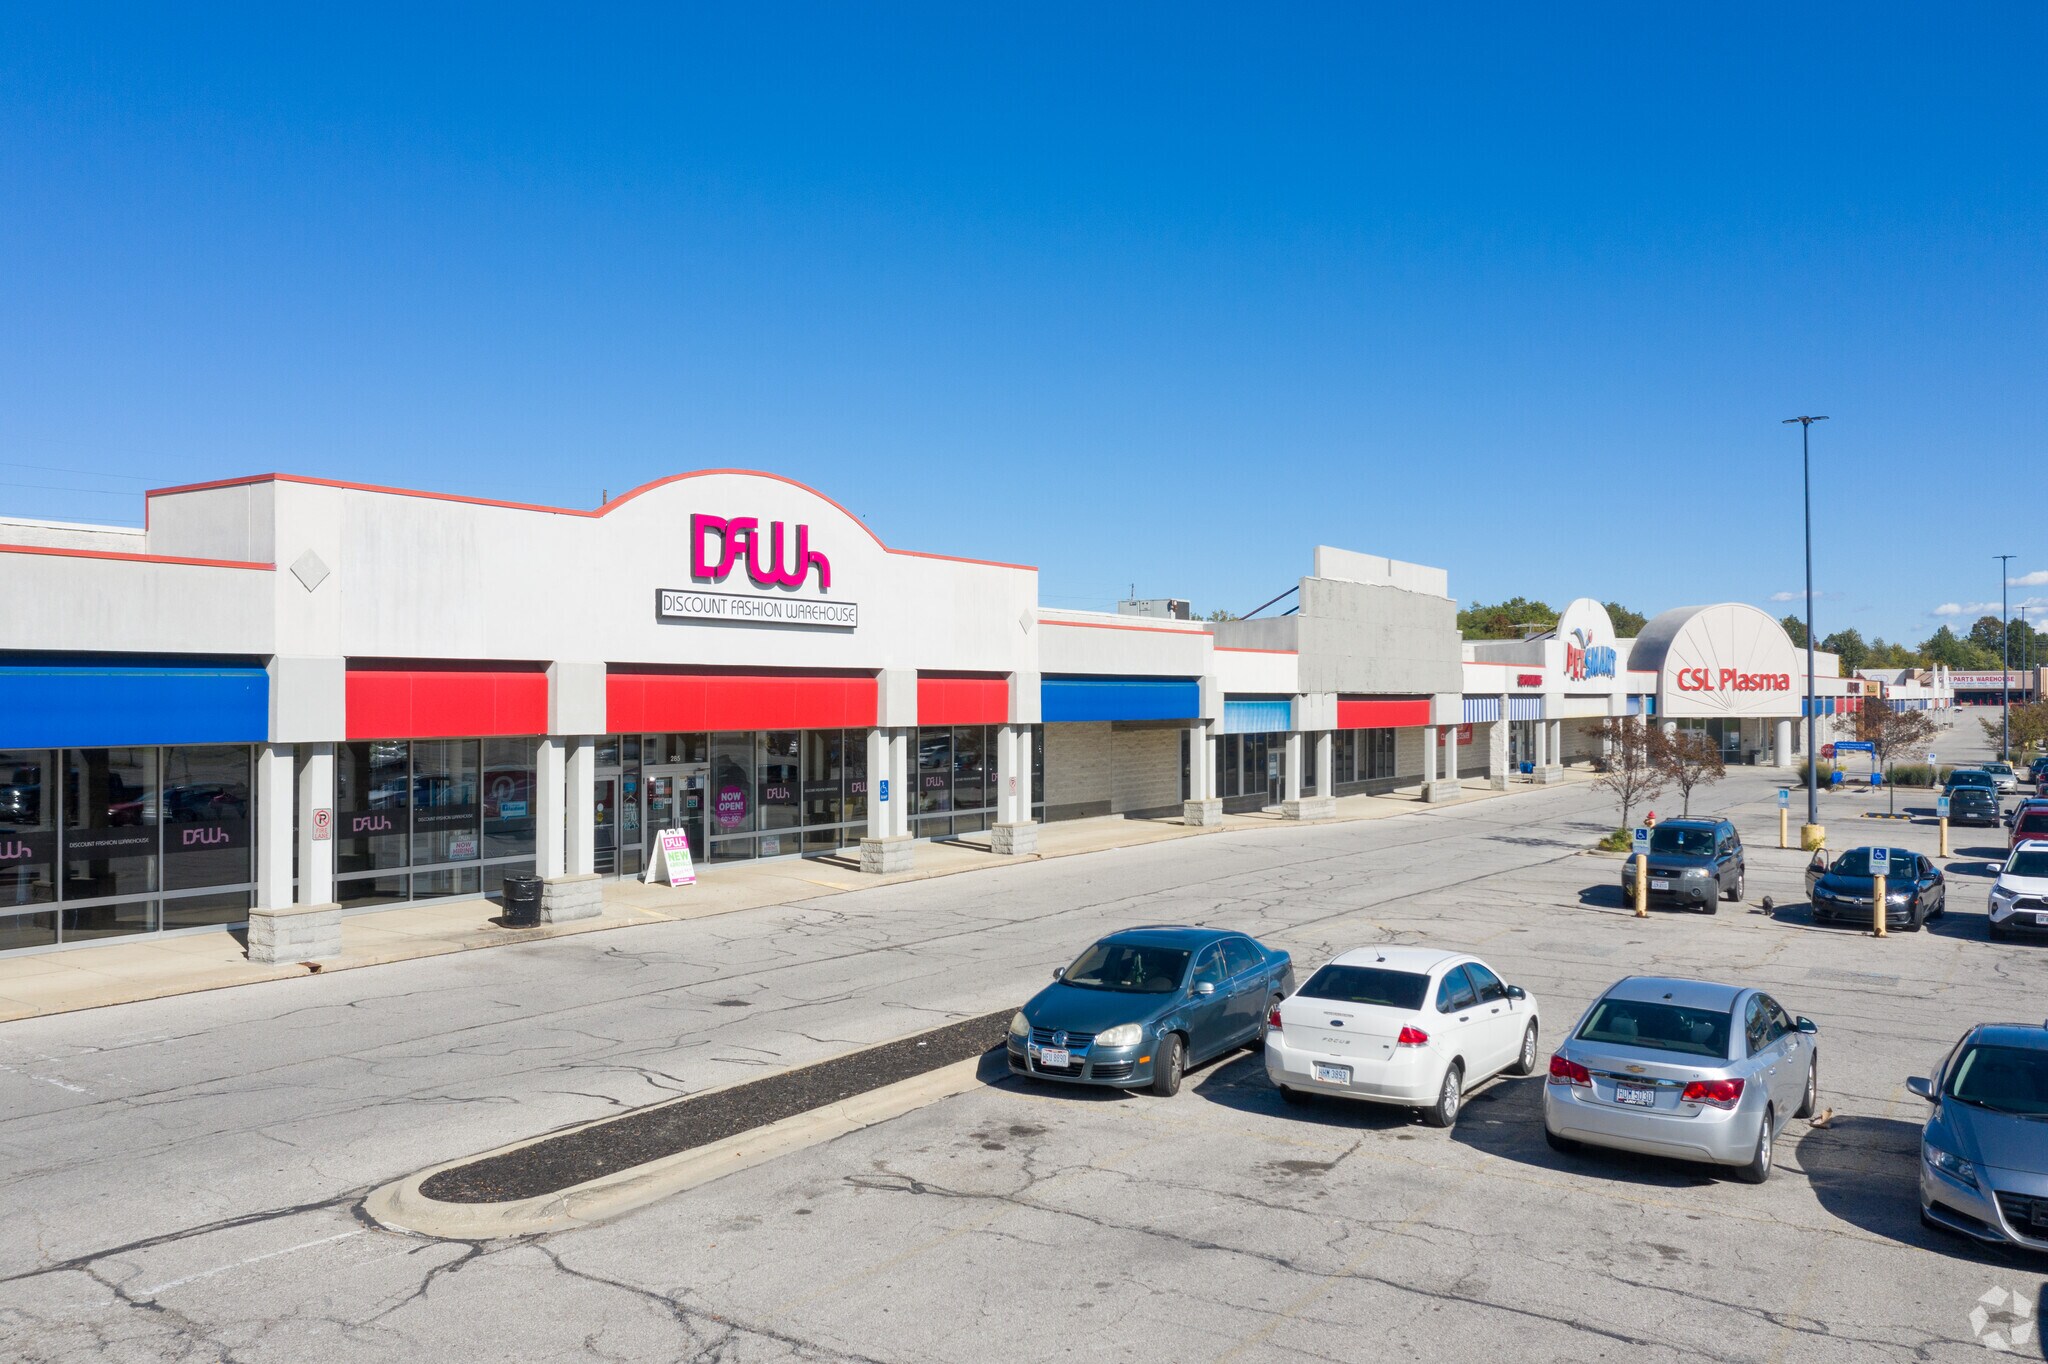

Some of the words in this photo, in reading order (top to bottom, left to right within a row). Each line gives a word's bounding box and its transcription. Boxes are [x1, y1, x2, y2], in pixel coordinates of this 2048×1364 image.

[663, 594, 727, 615] DISCOUNT
[731, 599, 782, 618] FASHION
[786, 604, 855, 623] WAREHOUSE
[1677, 668, 1714, 691] CSL
[1719, 668, 1790, 691] Plasma
[721, 792, 741, 801] NOW
[719, 802, 743, 811] OPEN!
[69, 840, 95, 848] DISCOUNT
[95, 839, 118, 847] FASHION
[118, 837, 149, 845] WAREHOUSE
[453, 847, 474, 855] HIRING
[668, 851, 688, 861] NEW
